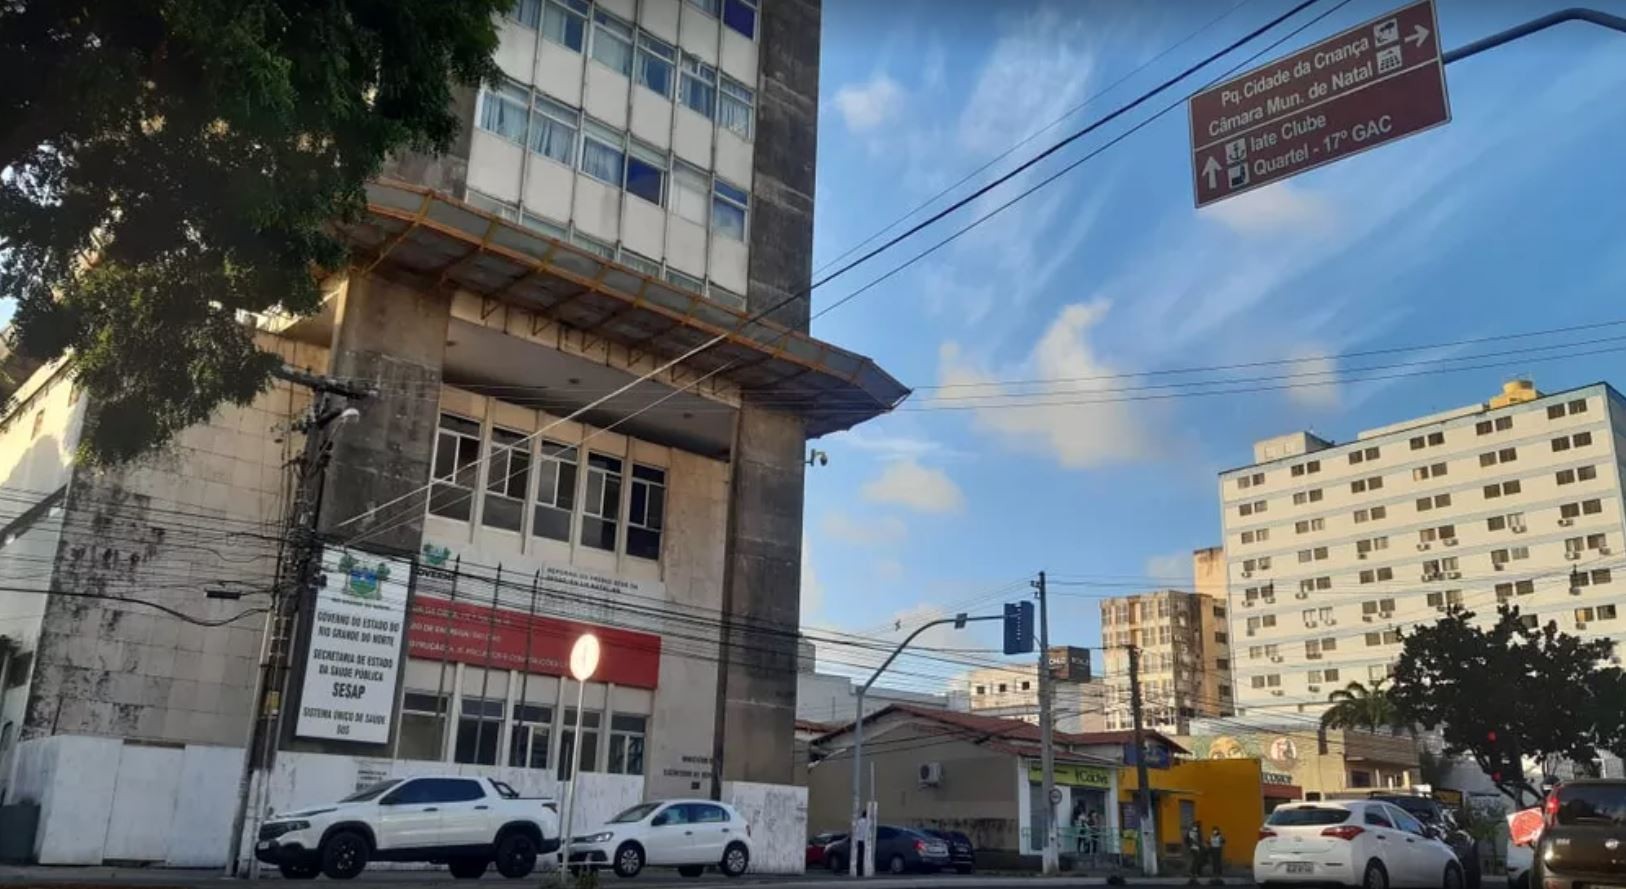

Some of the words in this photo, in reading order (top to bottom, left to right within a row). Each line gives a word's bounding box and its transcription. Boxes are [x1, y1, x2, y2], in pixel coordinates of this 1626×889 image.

[1221, 89, 1243, 107] Pq.
[1243, 71, 1290, 99] Cidade
[1293, 60, 1311, 79] da
[1314, 37, 1369, 69] Criança
[1209, 105, 1264, 137] Câmara
[1267, 93, 1304, 116] Mun.
[1309, 80, 1327, 99] de
[1332, 61, 1373, 91] Natal
[1251, 131, 1277, 152] Iate
[1281, 114, 1326, 140] Clube
[1253, 144, 1309, 176] Quartel
[1352, 116, 1393, 142] GAC
[318, 611, 350, 625] GOVERNO
[362, 617, 388, 631] ESTADO
[318, 626, 330, 637] RIO
[332, 628, 360, 641] GRANDE
[361, 632, 371, 643] DO
[372, 634, 394, 646] NORTE
[313, 648, 355, 663] SECRETARIA
[357, 654, 366, 665] DE
[367, 656, 393, 669] ESTADO
[319, 664, 328, 674] DA
[332, 682, 366, 699] SESAP
[303, 706, 332, 719] SISTEMA
